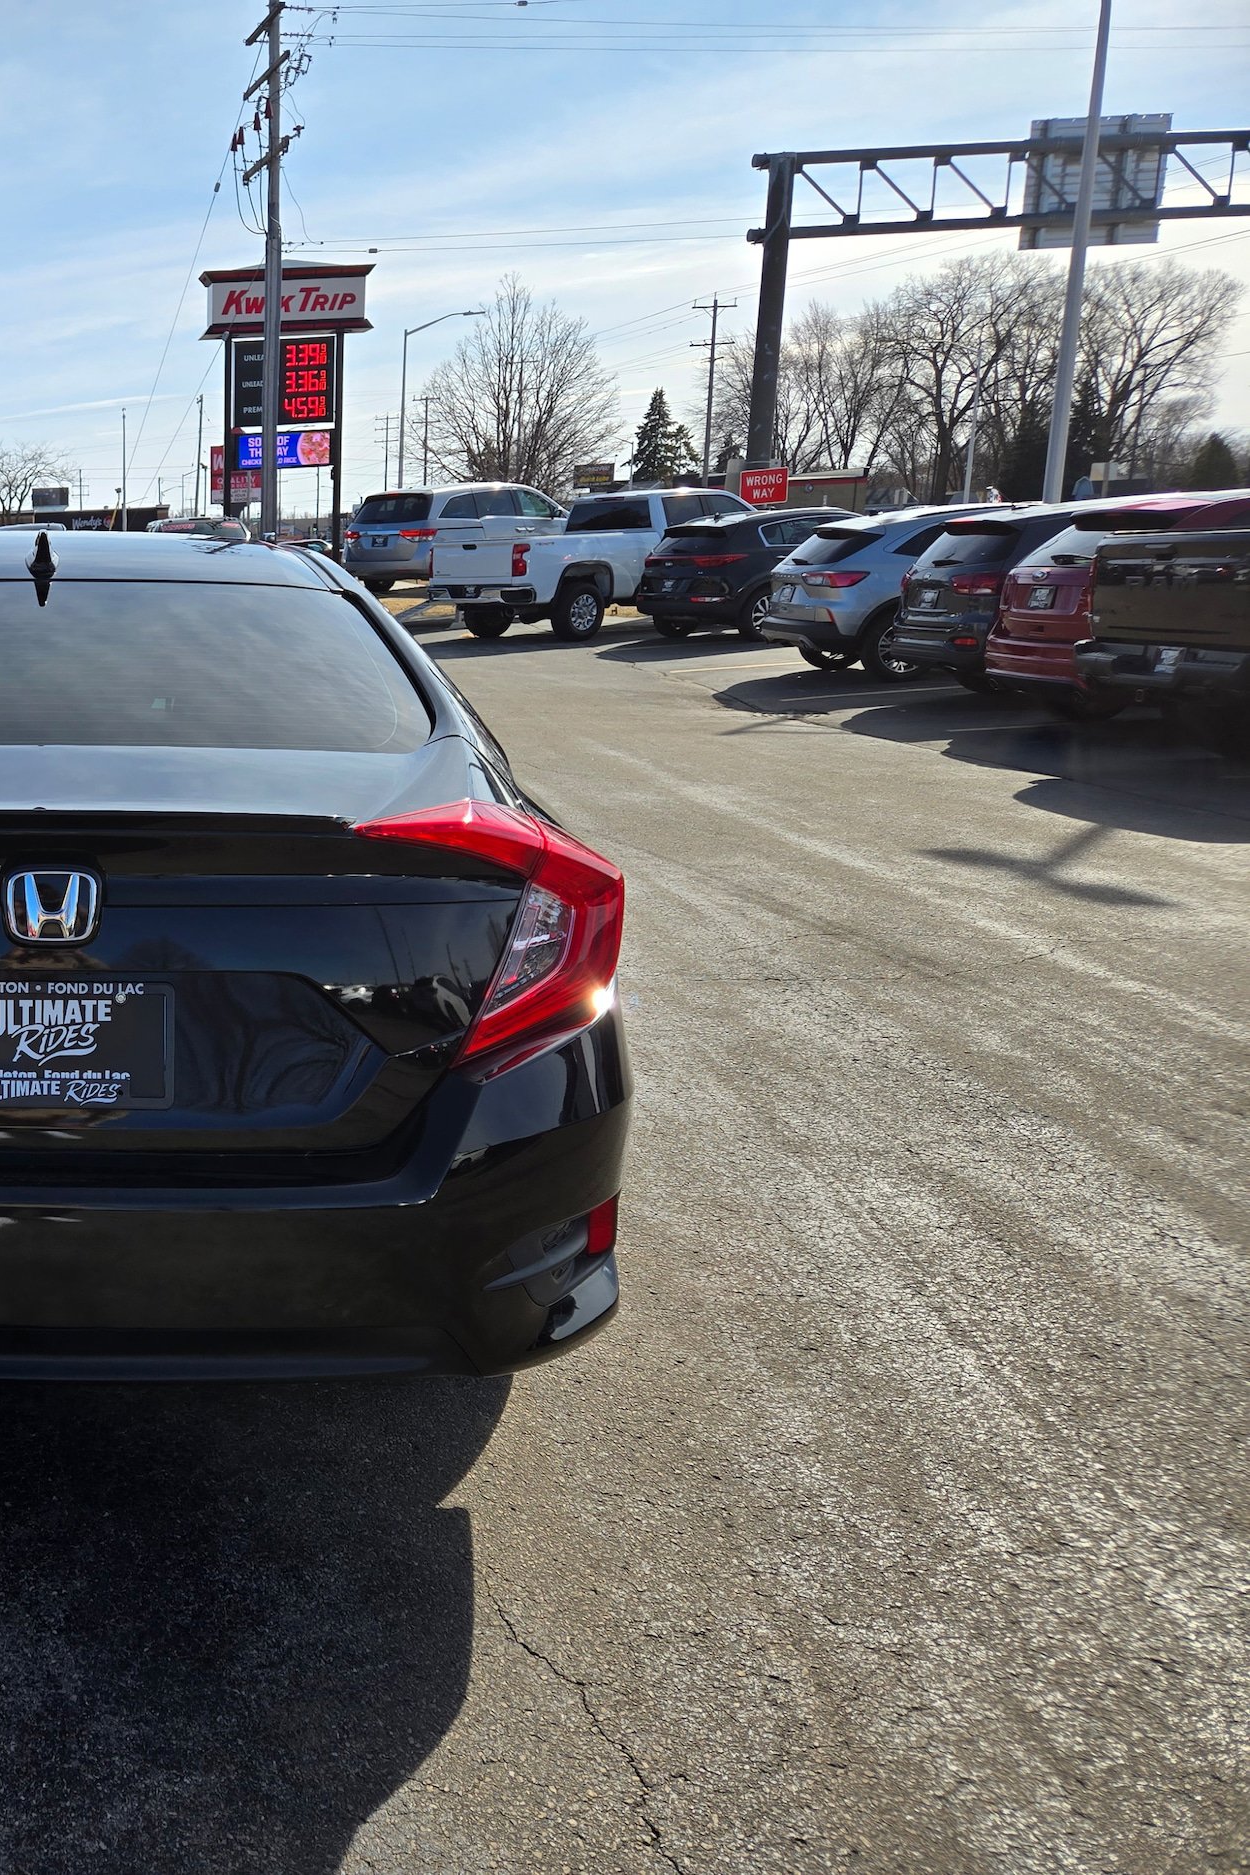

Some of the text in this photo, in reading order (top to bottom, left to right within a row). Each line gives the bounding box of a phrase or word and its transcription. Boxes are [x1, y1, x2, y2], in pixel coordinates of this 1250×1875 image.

[222, 286, 357, 315] KWK TRIP
[243, 354, 264, 362] UNLEA
[285, 344, 320, 367] 3.39
[285, 370, 319, 393] 3.36
[243, 406, 262, 414] PREM
[284, 396, 319, 418] 4.59
[248, 437, 262, 447] SO
[249, 446, 289, 458] TH AY
[746, 473, 783, 487] WRONG
[752, 487, 775, 499] WAY
[71, 515, 103, 530] Wendy's
[47, 982, 88, 995] FOND
[93, 983, 114, 995] DU
[118, 983, 144, 995] LAC
